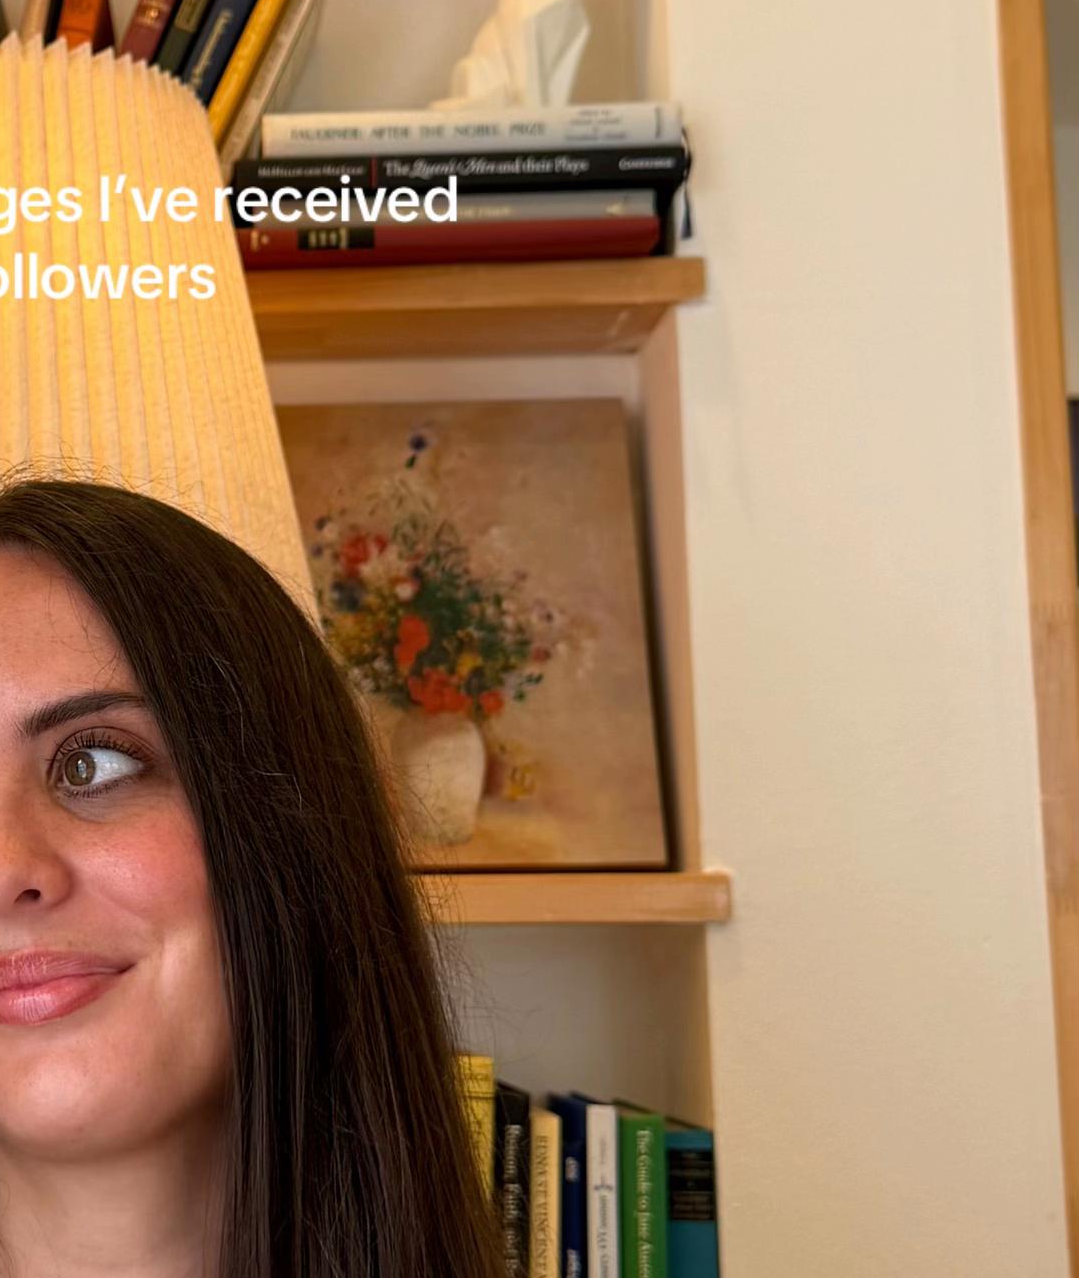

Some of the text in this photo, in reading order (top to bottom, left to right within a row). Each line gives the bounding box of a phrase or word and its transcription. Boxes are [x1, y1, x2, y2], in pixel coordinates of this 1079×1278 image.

[508, 121, 547, 137] PRIZE
[383, 161, 409, 177] The
[497, 158, 521, 174] and
[522, 156, 553, 172] their
[554, 155, 590, 175] Plays
[636, 1129, 653, 1154] The
[535, 1134, 549, 1177] EDNA
[636, 1155, 653, 1194] Guide
[638, 1195, 652, 1210] to
[634, 1210, 654, 1239] Jane
